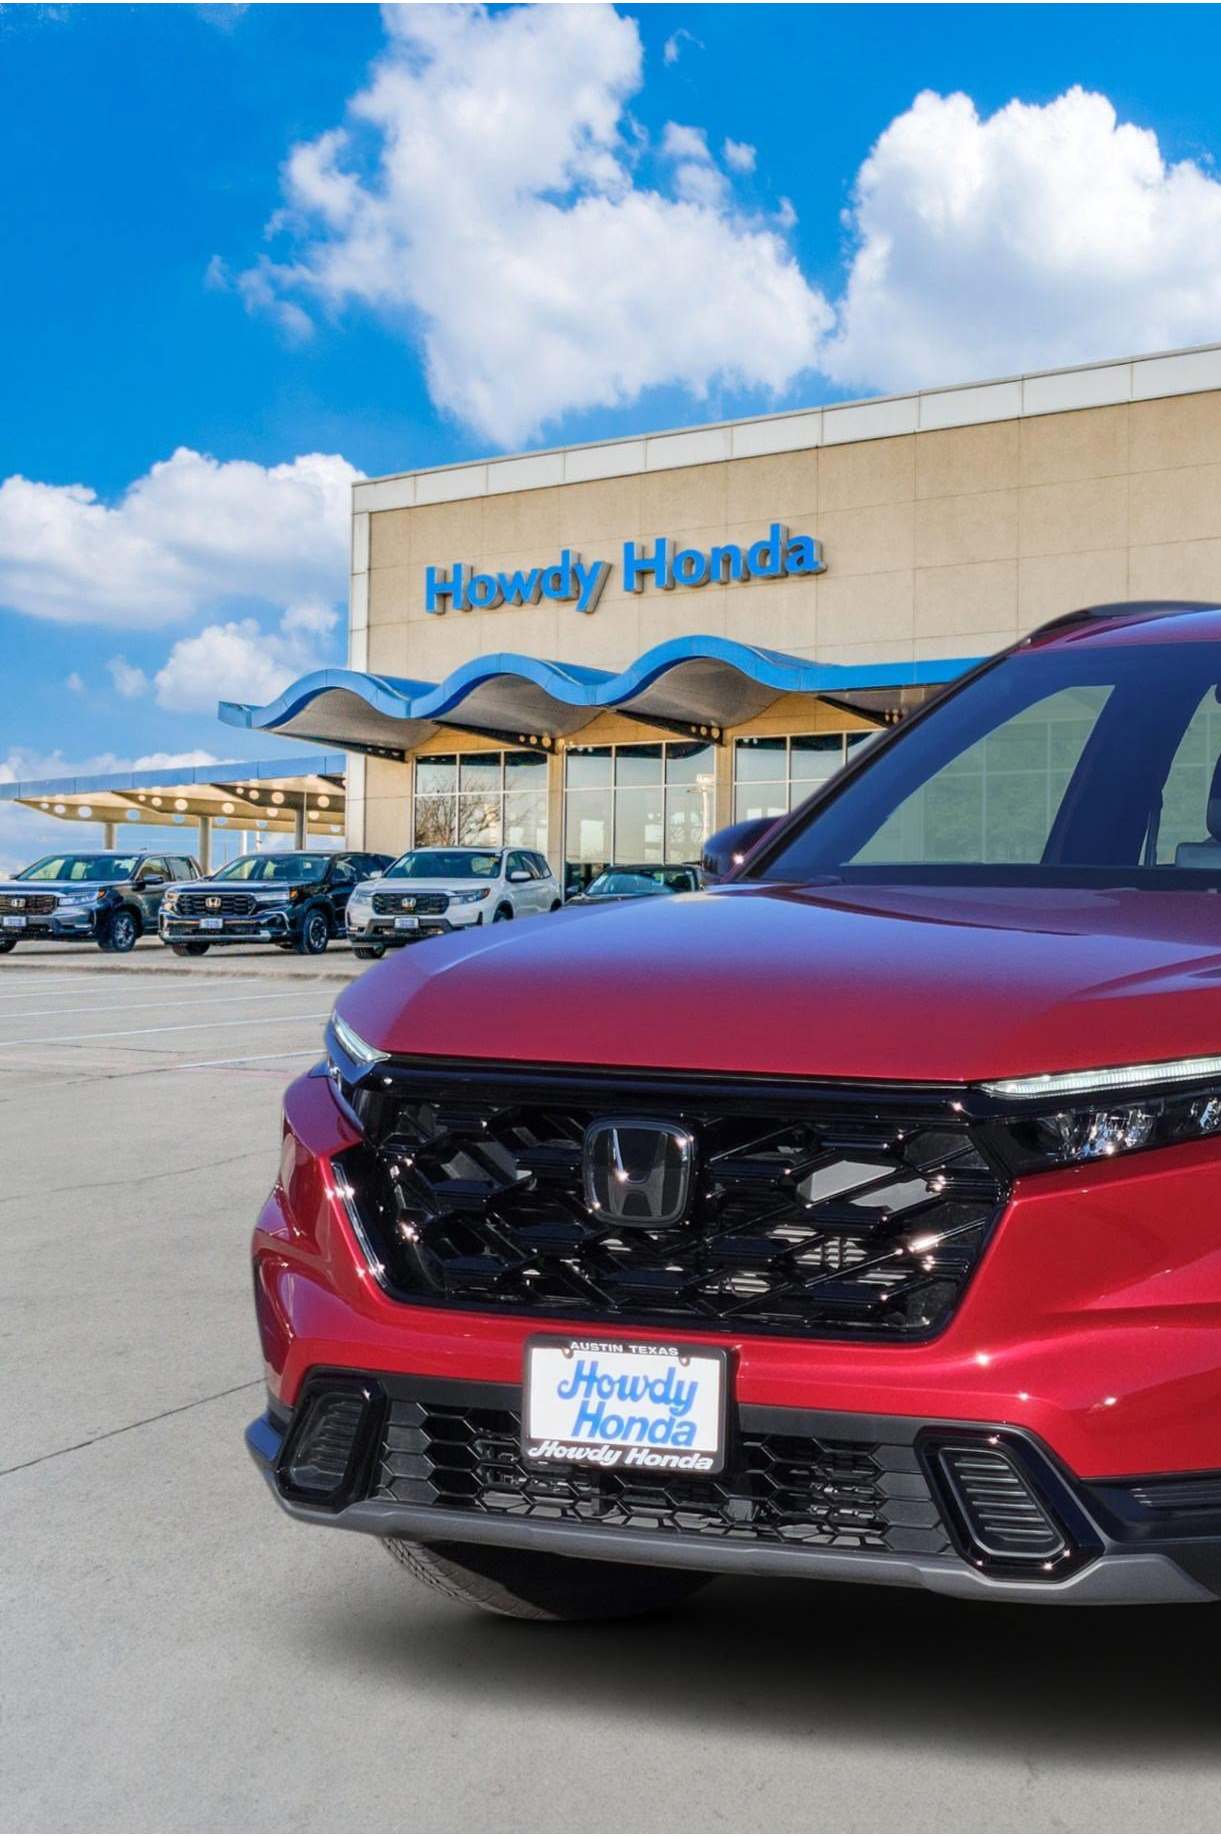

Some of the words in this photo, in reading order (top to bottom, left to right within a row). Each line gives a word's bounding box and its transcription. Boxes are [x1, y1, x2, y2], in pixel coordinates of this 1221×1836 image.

[424, 548, 612, 615] Howdy
[623, 522, 828, 594] Honda
[570, 1341, 624, 1353] AUSTIN
[629, 1344, 679, 1357] TEXAS
[556, 1359, 699, 1417] Howdy
[571, 1400, 698, 1447] Honda
[528, 1440, 622, 1467] Howdy
[624, 1447, 714, 1470] Honda
